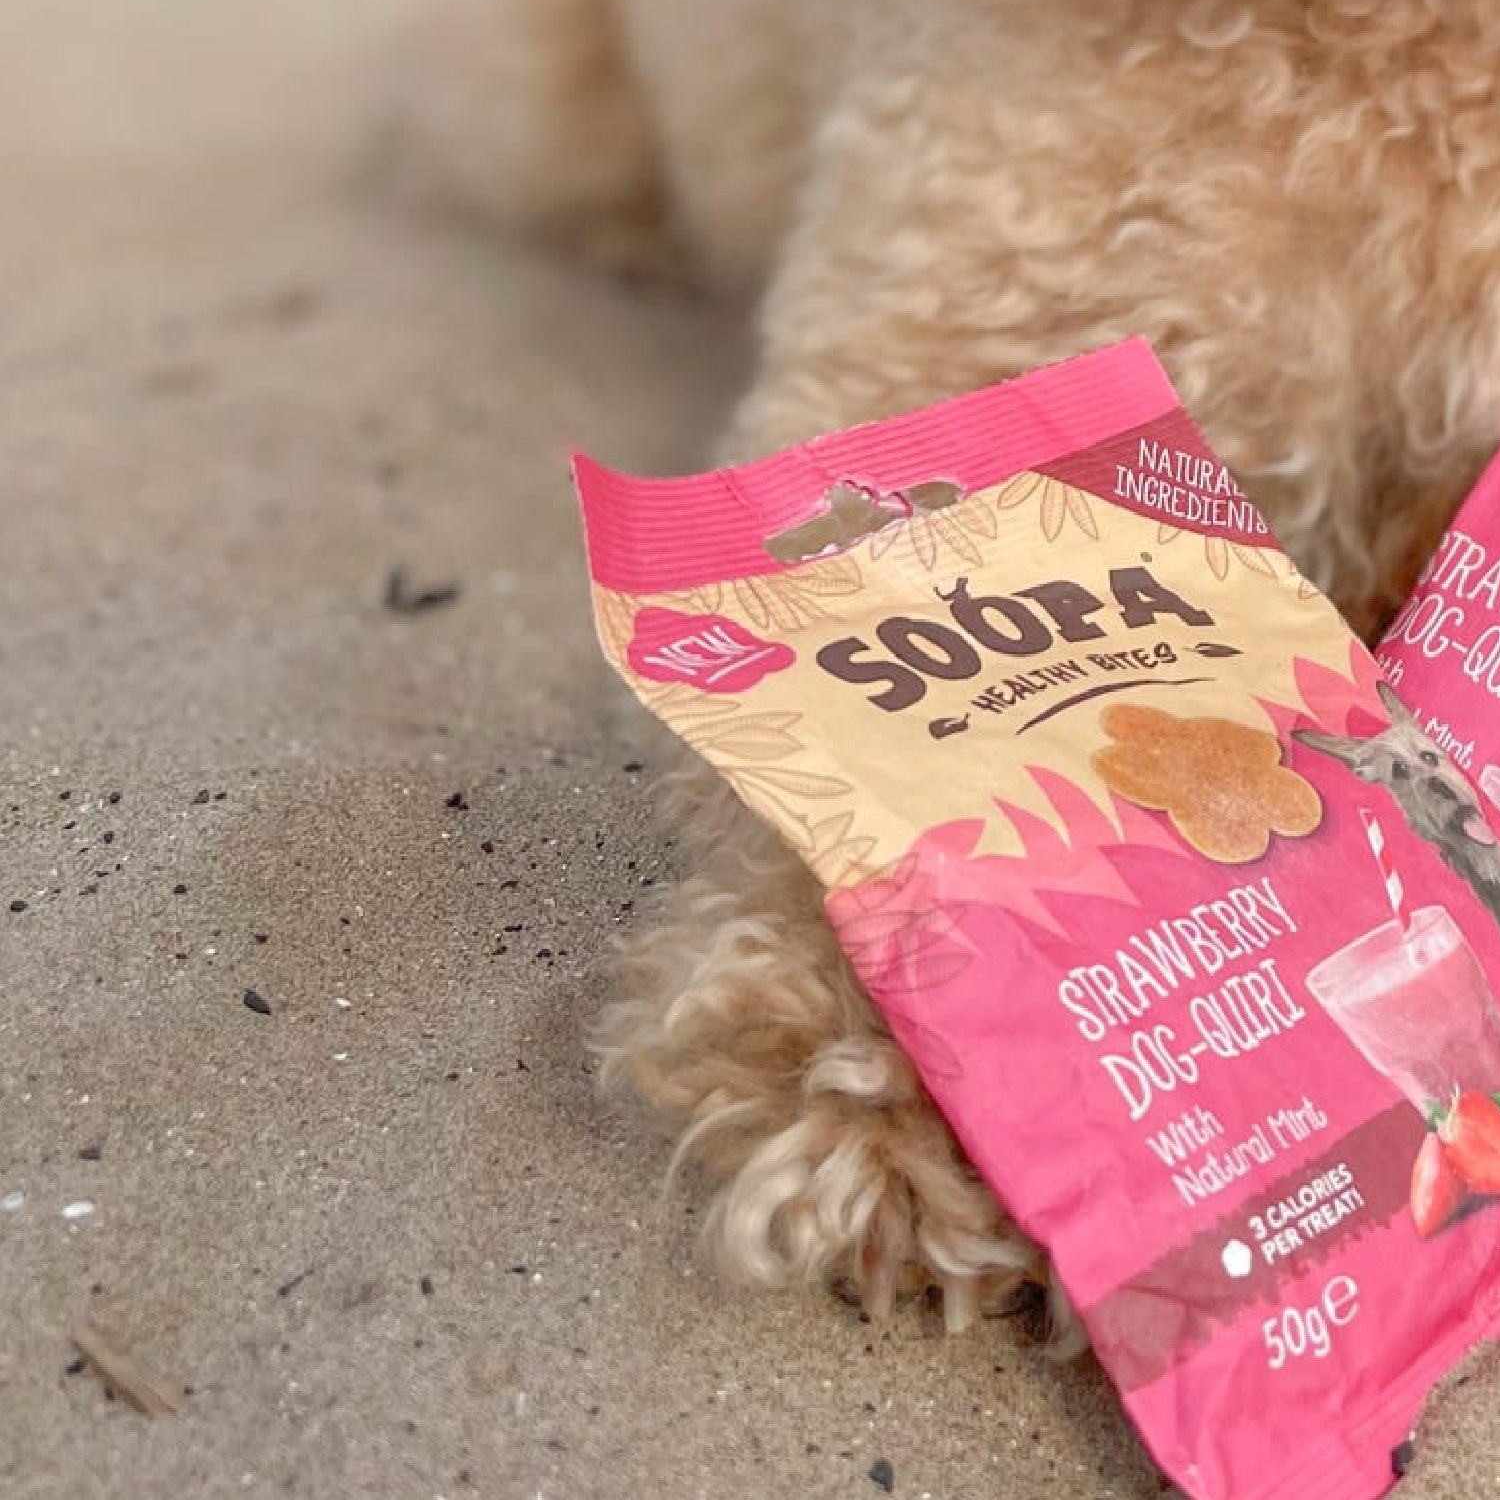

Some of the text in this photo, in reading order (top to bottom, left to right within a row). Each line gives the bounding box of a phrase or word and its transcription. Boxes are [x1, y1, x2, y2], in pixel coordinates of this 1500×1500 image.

[642, 624, 758, 677] NEW
[815, 566, 1216, 713] SOOPA
[970, 641, 1179, 714] HEALTHY BITES
[1058, 876, 1298, 1041] STRAWBERRY
[1100, 958, 1306, 1121] DOG-QUIRI
[1144, 1104, 1226, 1167] With
[1171, 1096, 1329, 1207] Natural Mint
[1248, 1162, 1354, 1240] 3 CALORIES
[1260, 1187, 1366, 1266] PER TREAT!
